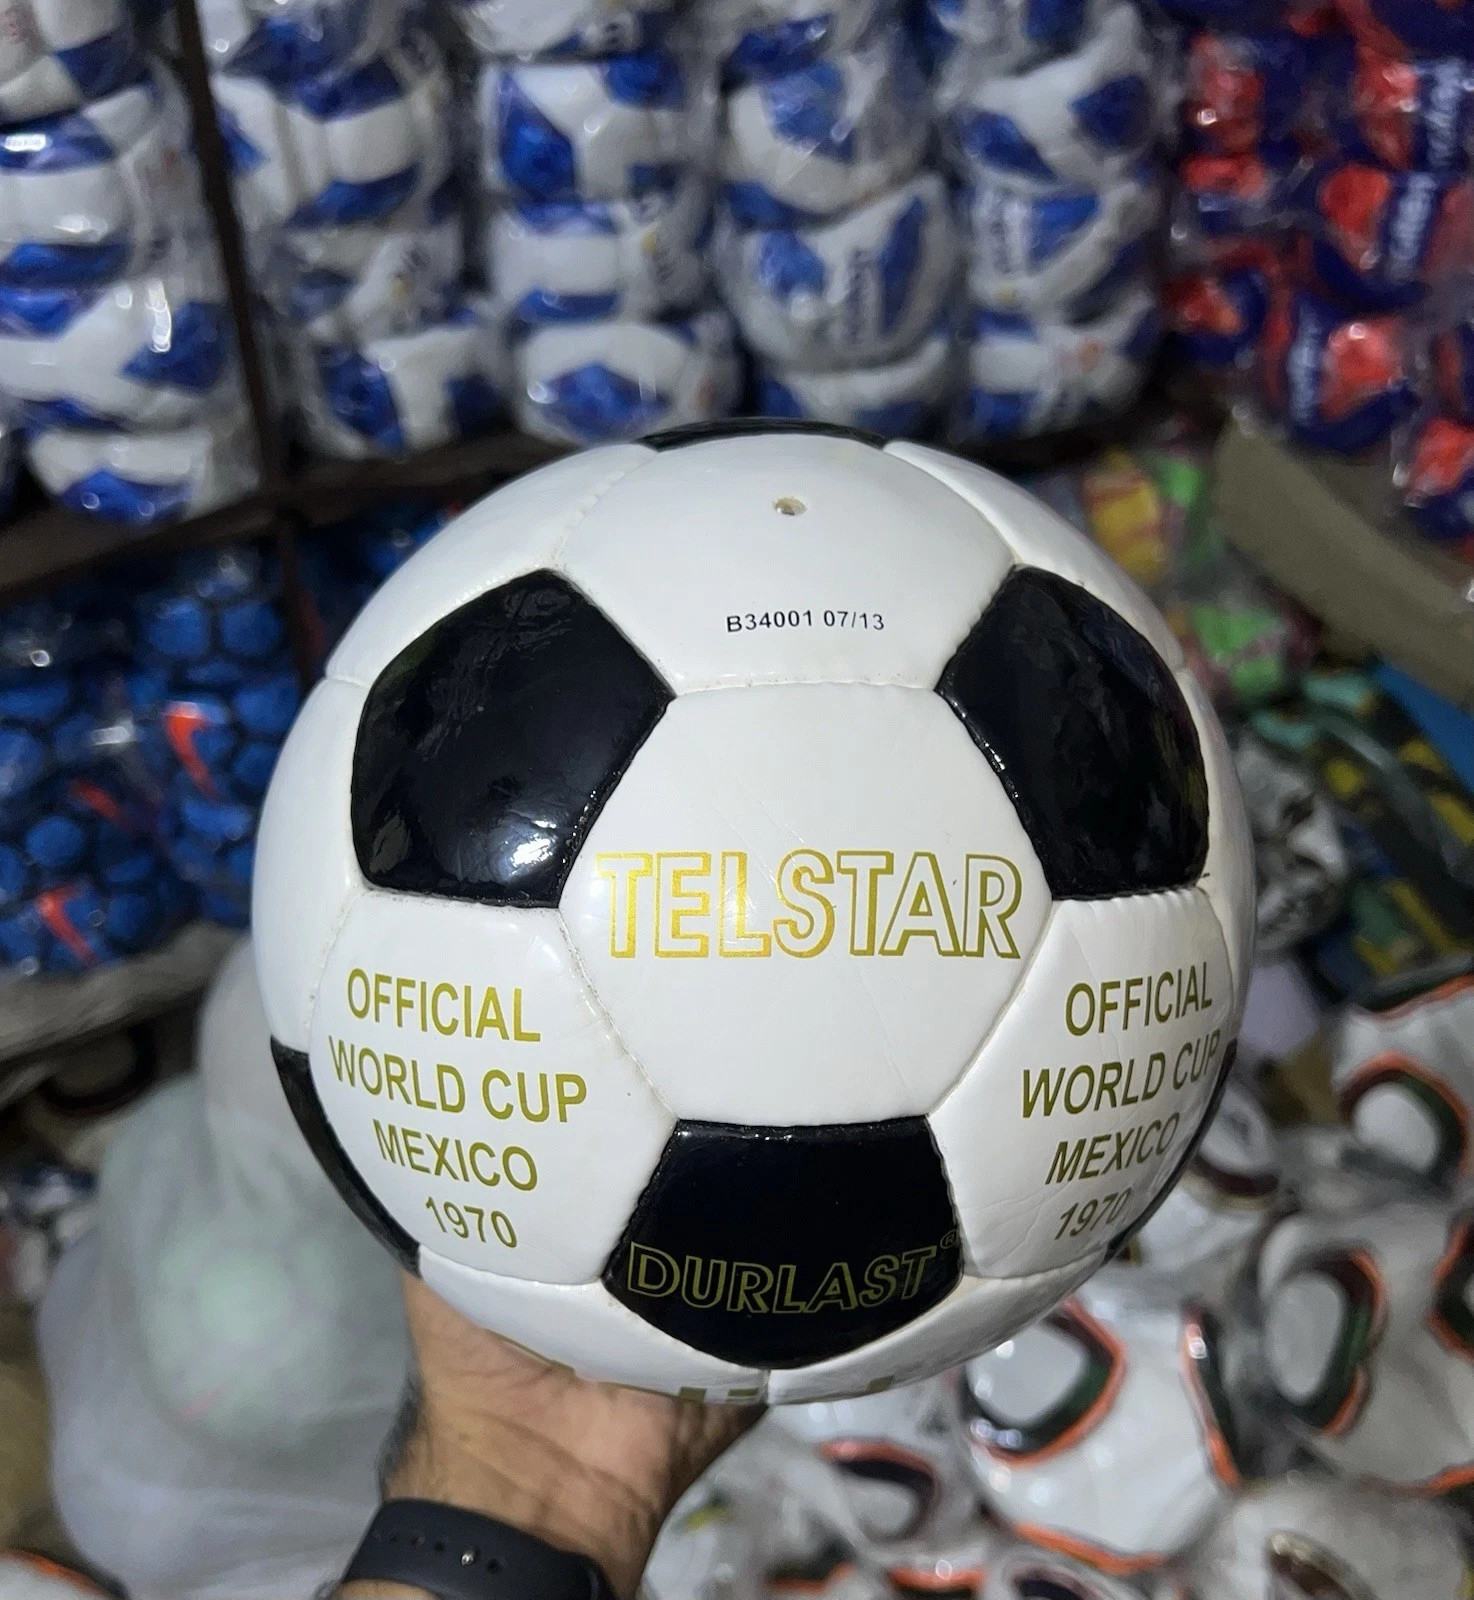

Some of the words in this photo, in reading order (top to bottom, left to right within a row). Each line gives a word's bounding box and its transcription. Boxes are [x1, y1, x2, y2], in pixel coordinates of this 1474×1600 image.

[725, 609, 813, 632] B34001
[823, 610, 885, 631] 07/13
[594, 848, 1022, 960] TELSTAR
[346, 967, 541, 1043] OFFICIAL
[1064, 961, 1213, 1037] OFFICIAL
[328, 1034, 466, 1114] WORLD
[481, 1068, 588, 1124] CUP
[1021, 1051, 1167, 1119] WORLD
[1172, 1028, 1221, 1091] CUP
[372, 1118, 538, 1192] MEXICO
[1044, 1111, 1181, 1186] MEXICO
[425, 1196, 518, 1249] 1970
[1053, 1187, 1132, 1241] 1970
